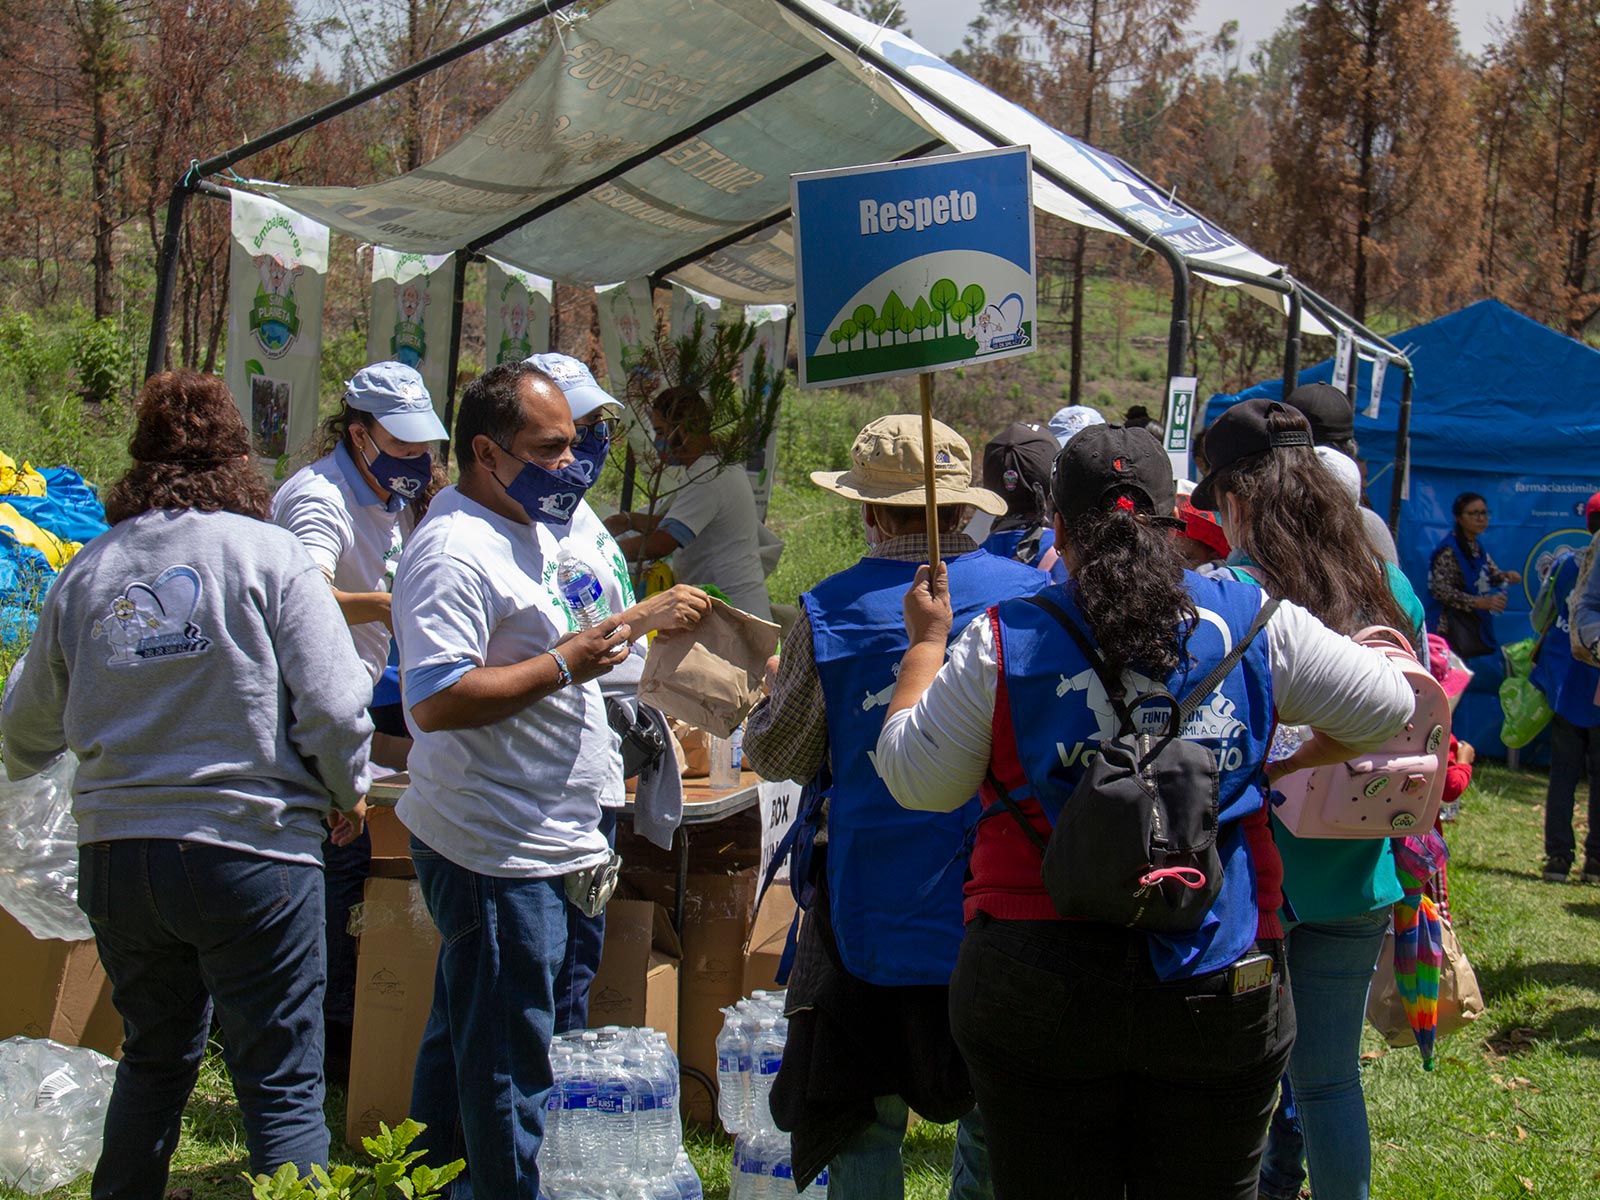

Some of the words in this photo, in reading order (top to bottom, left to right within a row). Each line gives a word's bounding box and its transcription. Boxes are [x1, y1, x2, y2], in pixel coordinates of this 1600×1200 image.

[859, 189, 978, 235] Respeto
[253, 213, 304, 259] Embajadores
[258, 307, 291, 324] PLANETA
[1515, 482, 1600, 494] farmaciassimila
[1201, 725, 1220, 736] A.C.
[769, 794, 790, 829] BOX
